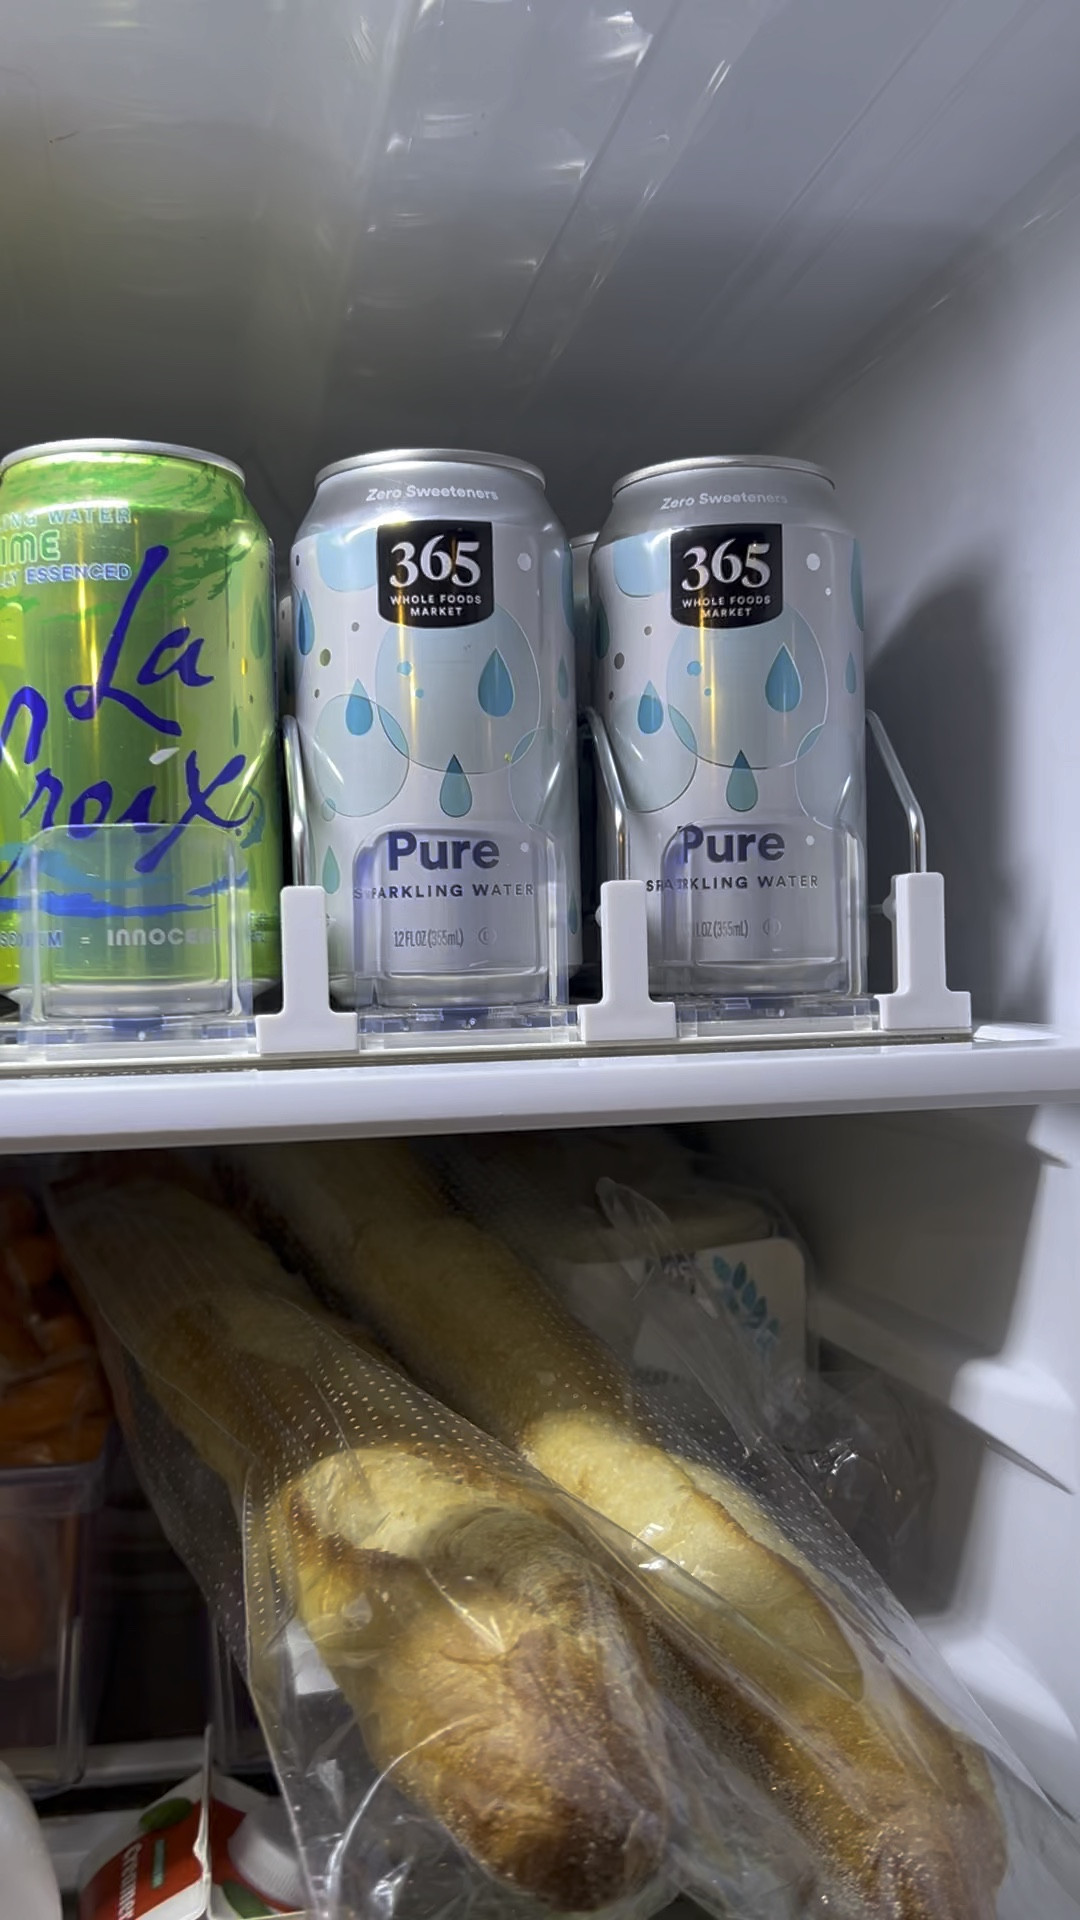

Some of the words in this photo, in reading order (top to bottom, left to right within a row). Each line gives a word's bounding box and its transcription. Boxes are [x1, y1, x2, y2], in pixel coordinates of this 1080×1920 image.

[366, 488, 402, 501] Zero
[406, 485, 499, 500] Sweeteners
[660, 498, 695, 510] Zero
[699, 492, 788, 505] Sweeteners
[48, 507, 132, 525] WATER
[389, 534, 481, 587] 365
[681, 538, 771, 592] 365
[25, 563, 132, 586] ESSENCED
[390, 594, 435, 606] WHOLE
[439, 594, 482, 605] FOODS
[682, 596, 725, 608] WHOLE
[730, 595, 771, 605] FOODS
[411, 607, 463, 617] MARKET
[702, 608, 752, 618] MARKET
[64, 545, 215, 736] La
[388, 830, 500, 871] Pure
[677, 824, 786, 864] Pure
[472, 883, 534, 897] WATER
[757, 874, 818, 888] WATER
